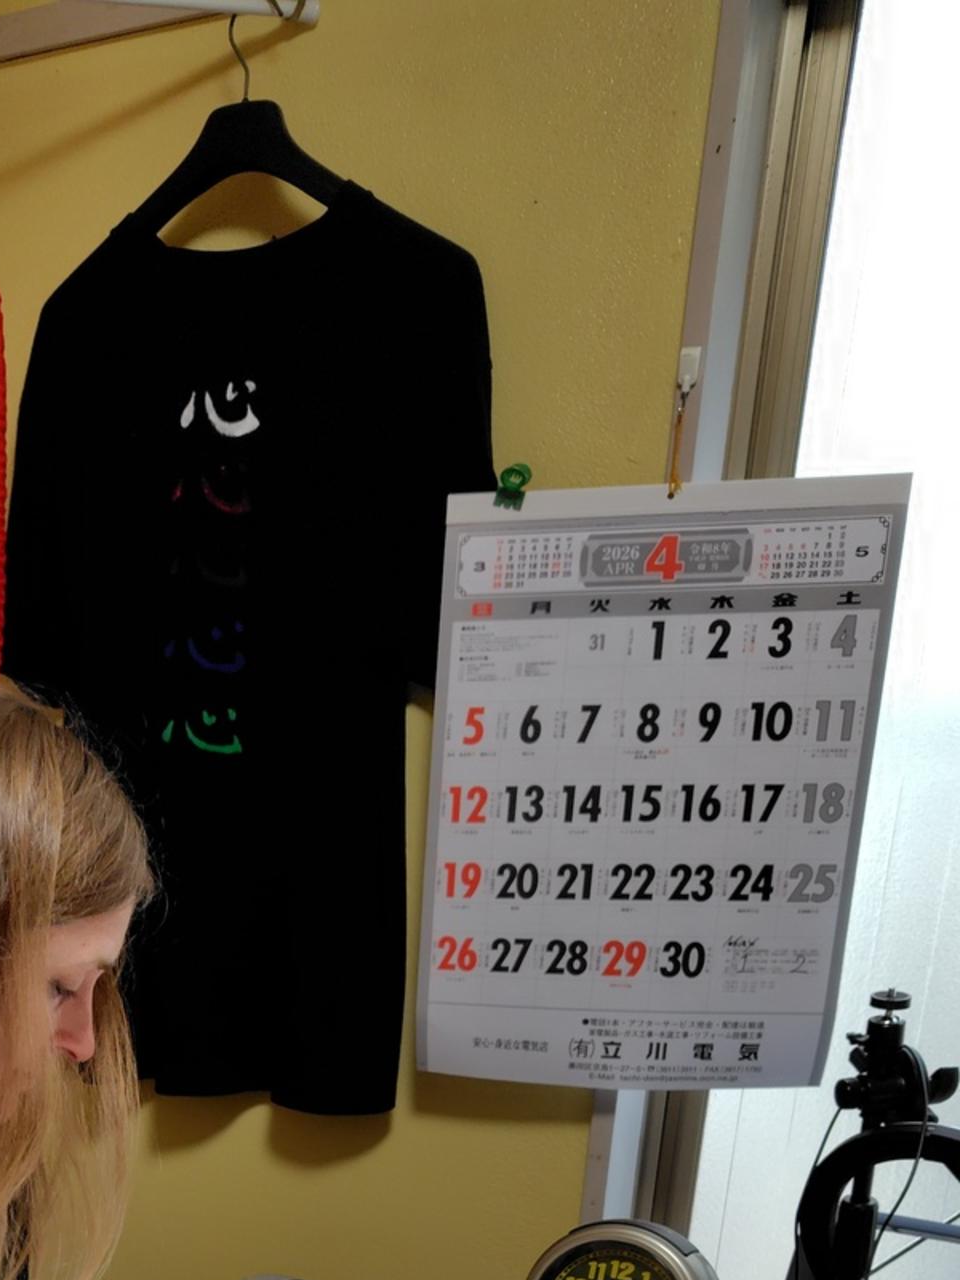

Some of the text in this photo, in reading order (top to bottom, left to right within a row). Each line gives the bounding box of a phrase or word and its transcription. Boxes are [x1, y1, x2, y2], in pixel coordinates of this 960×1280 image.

[180, 380, 260, 437] 心
[602, 546, 640, 561] 2026
[604, 563, 635, 574] APR
[644, 533, 685, 582] 4
[690, 543, 729, 554] 令和8年
[855, 546, 869, 557] 5
[530, 600, 552, 615] 月
[590, 599, 611, 613] 火
[649, 597, 672, 611] 水
[710, 595, 734, 609] 木
[772, 592, 798, 608] 金
[836, 591, 861, 606] 土
[164, 618, 245, 672] 心
[589, 633, 606, 651] 31
[651, 620, 666, 661] 1
[707, 618, 732, 659] 2
[767, 616, 793, 659] 3
[830, 614, 858, 658] 4
[162, 708, 242, 754] 心
[463, 699, 857, 746] 5 6 7 8 9 10 11
[449, 782, 846, 824] 12 13 14 15 16 17 18
[444, 862, 838, 904] 19 20 21 22 23 24 25
[437, 935, 706, 979] 26 27 28 29 30
[789, 953, 808, 974] 2
